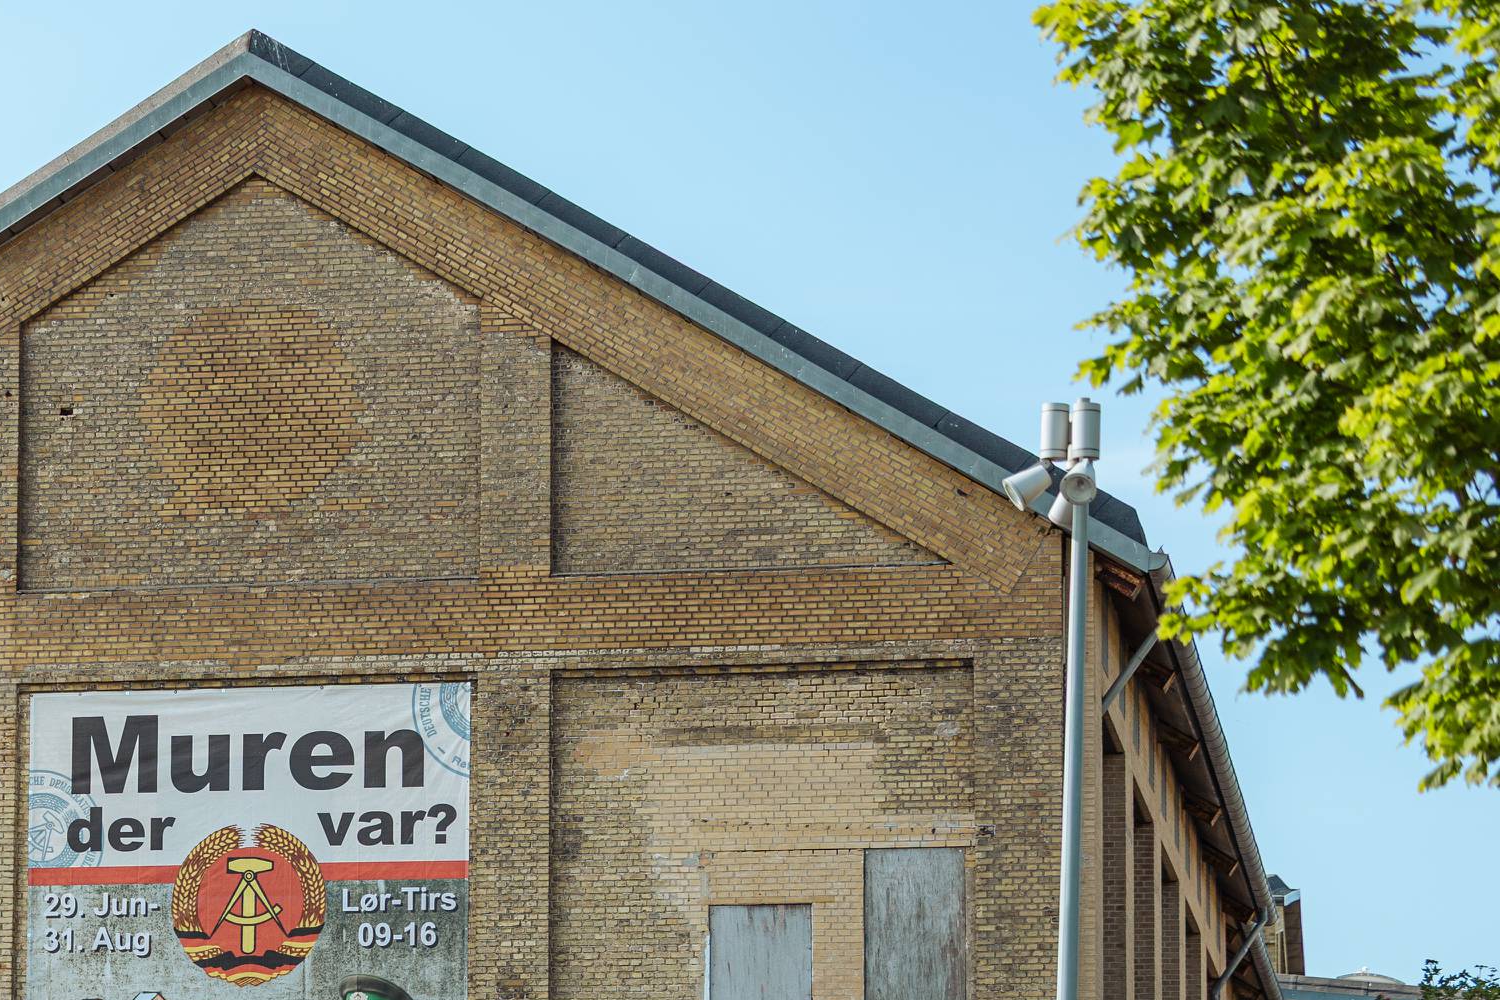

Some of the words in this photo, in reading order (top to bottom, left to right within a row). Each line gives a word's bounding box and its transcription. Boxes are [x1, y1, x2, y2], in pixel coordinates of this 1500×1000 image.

[420, 687, 438, 738] DEUTSCHE
[72, 714, 424, 795] Muren
[66, 806, 176, 853] der
[317, 803, 457, 847] var?
[43, 893, 85, 918] 29.
[93, 892, 160, 918] Jun-
[342, 886, 458, 913] Lør-Tirs
[43, 927, 85, 953] 31.
[91, 926, 152, 958] Aug
[358, 921, 439, 948] 09-16
